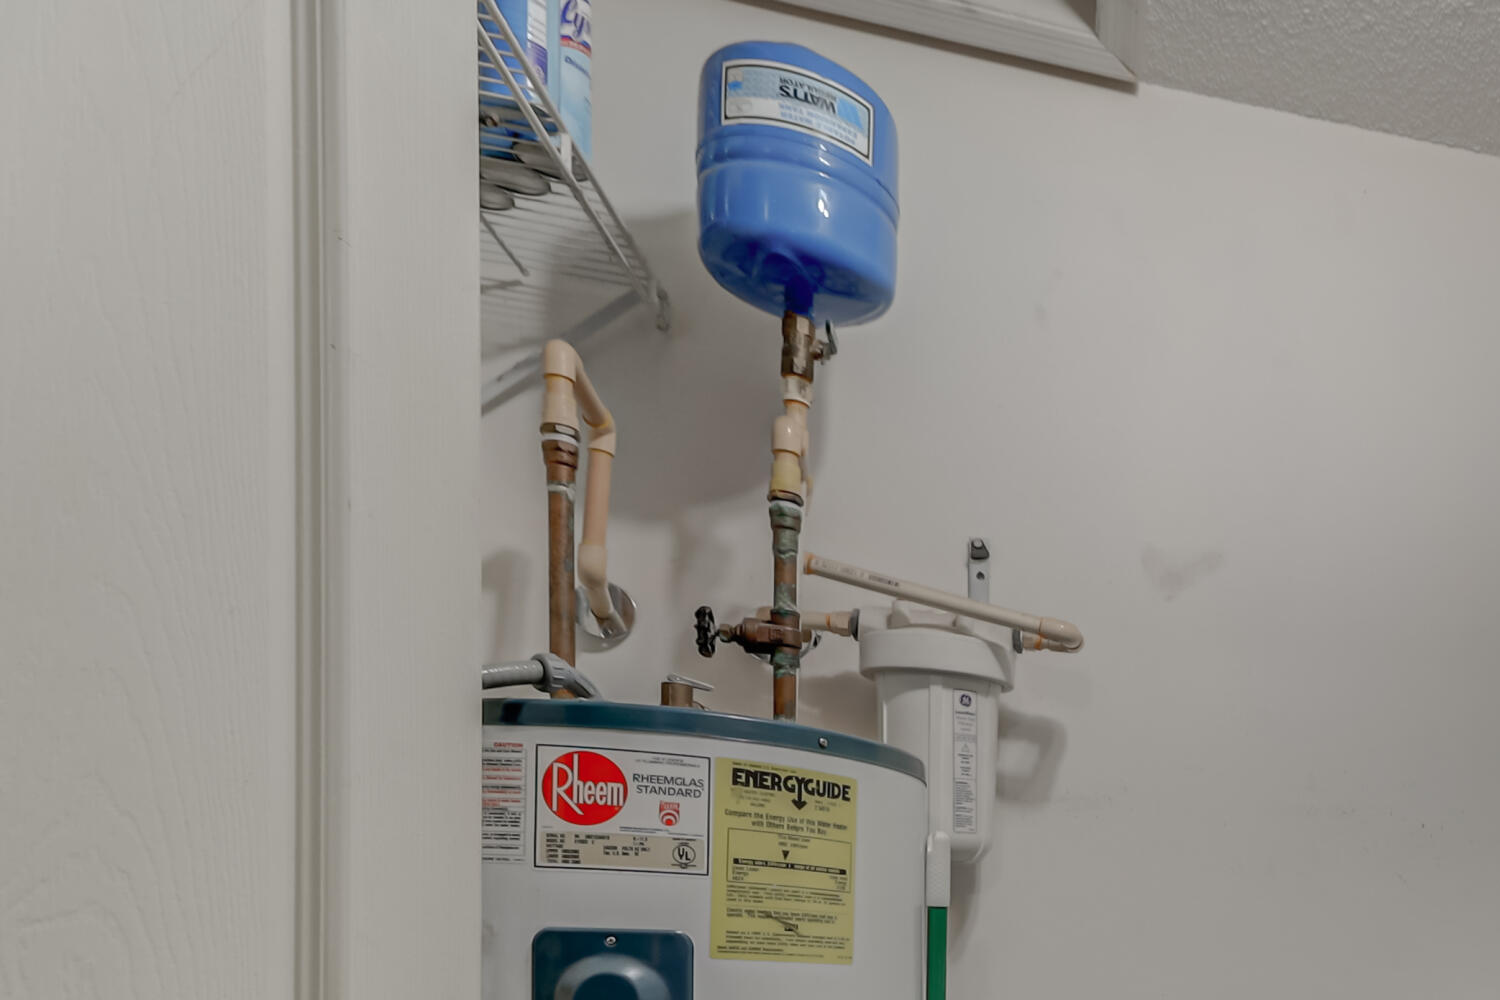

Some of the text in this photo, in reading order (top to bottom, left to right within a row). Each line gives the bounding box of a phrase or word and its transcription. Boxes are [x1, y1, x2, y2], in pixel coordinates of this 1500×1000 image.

[779, 85, 836, 115] WATTS
[552, 753, 624, 816] Rheem
[633, 773, 704, 789] RHEEMGLAS
[731, 767, 851, 802] ENERGYGUIDE
[636, 786, 702, 799] STANDARD
[724, 809, 752, 819] Compare
[765, 812, 785, 823] Energy
[766, 820, 785, 830] Others
